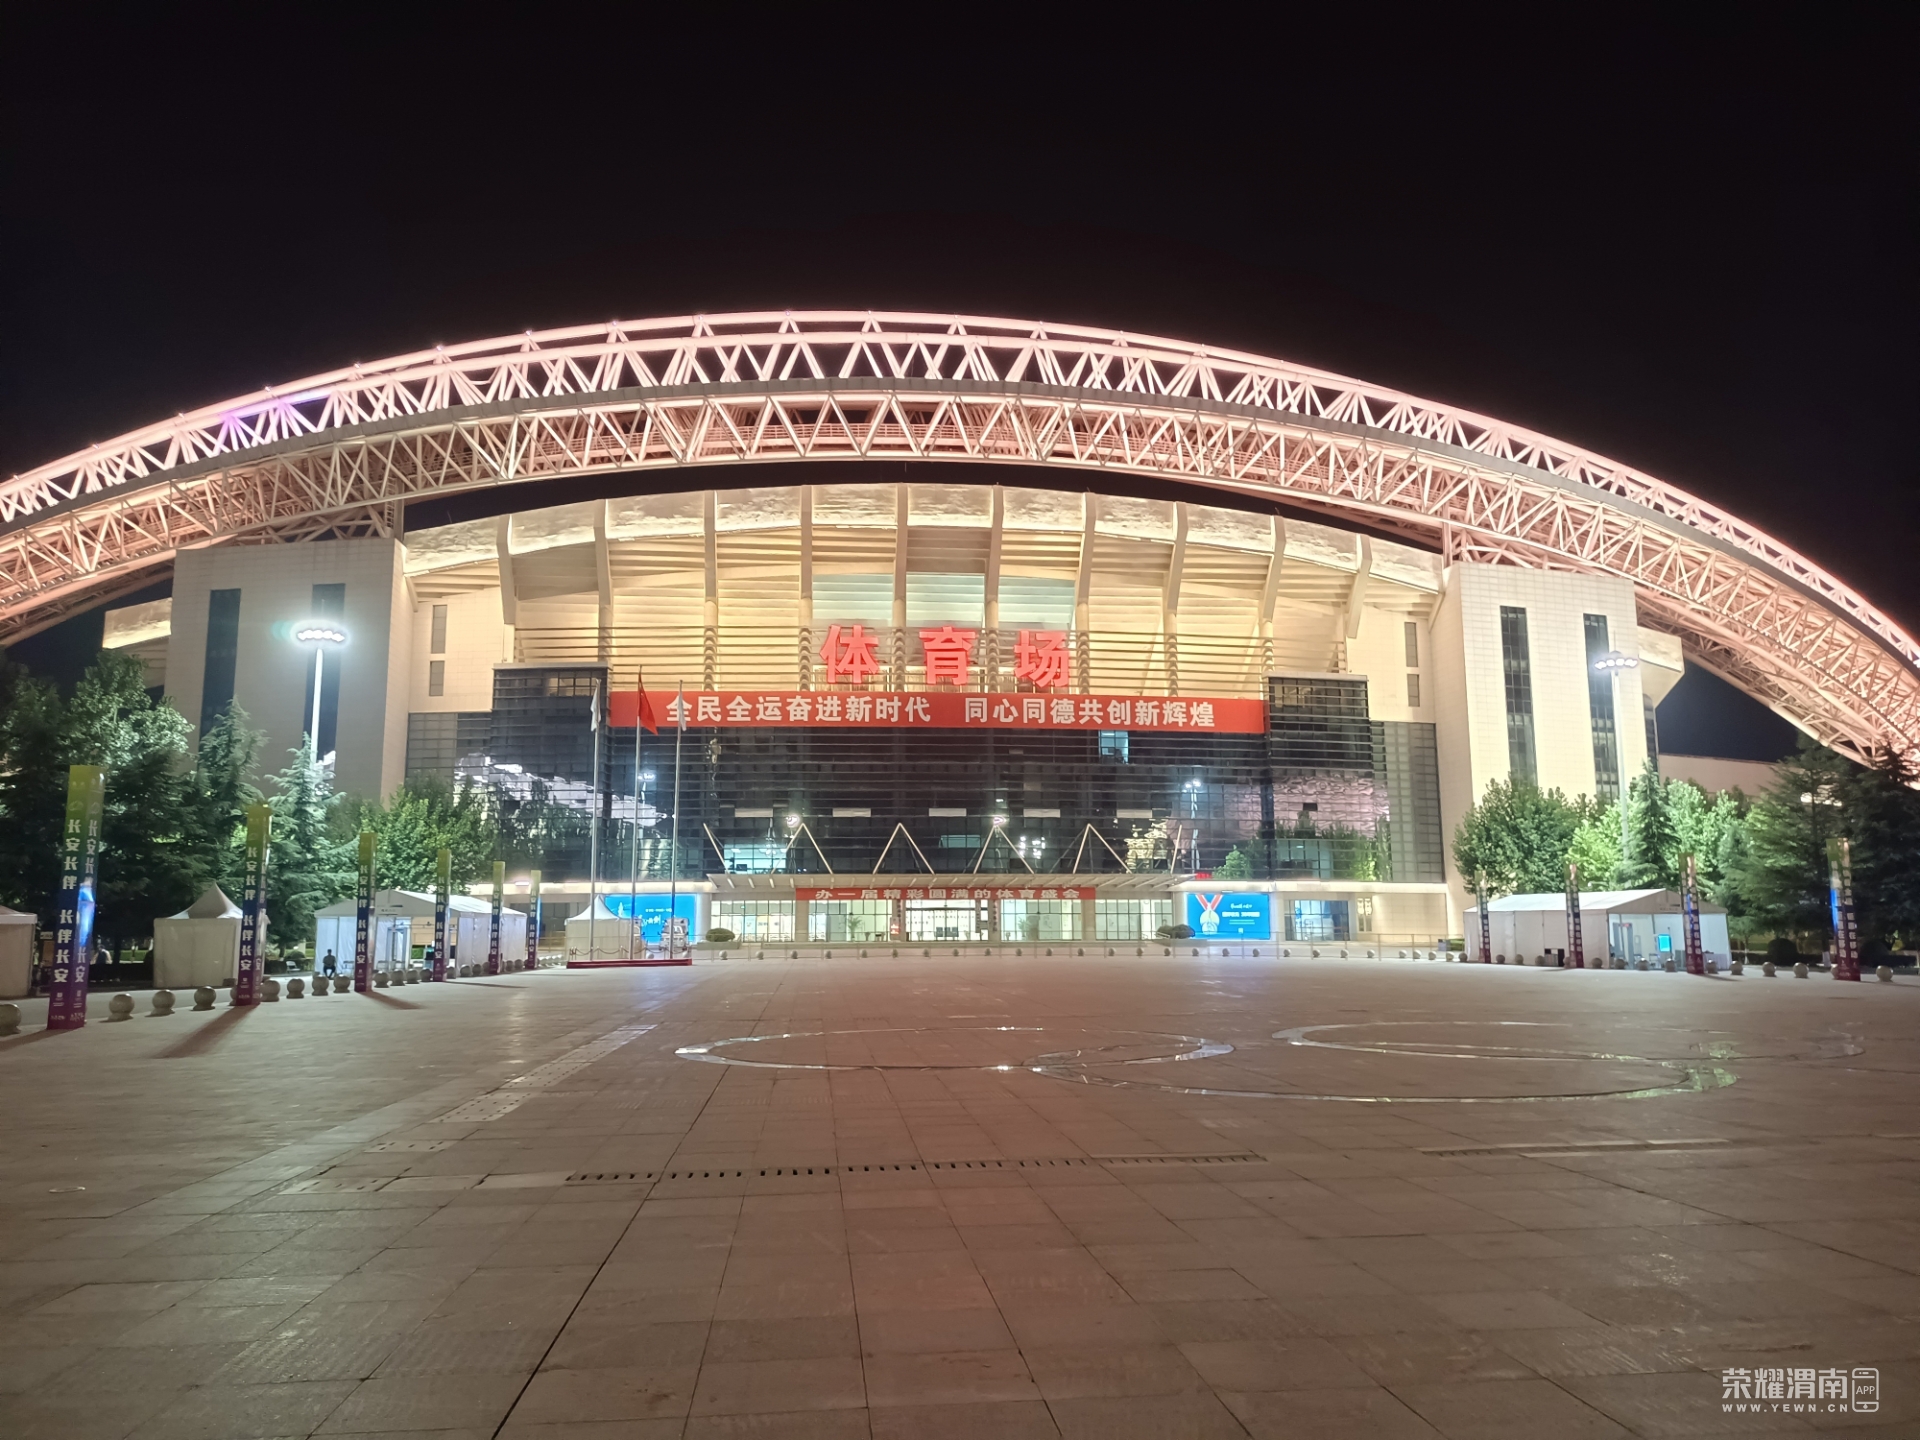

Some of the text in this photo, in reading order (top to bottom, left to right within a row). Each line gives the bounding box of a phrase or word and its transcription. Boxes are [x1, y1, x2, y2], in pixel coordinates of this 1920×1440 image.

[819, 624, 1070, 688] 体育场
[666, 695, 1216, 729] 全民全运奋进新时代 同心同德共创新辉煌
[63, 818, 81, 891] 长安长伴
[240, 846, 258, 971] 长安长伴 长伴长安
[815, 888, 1080, 899] 办一届精彩圆满的体育盛会
[53, 908, 74, 983] 长伴长安
